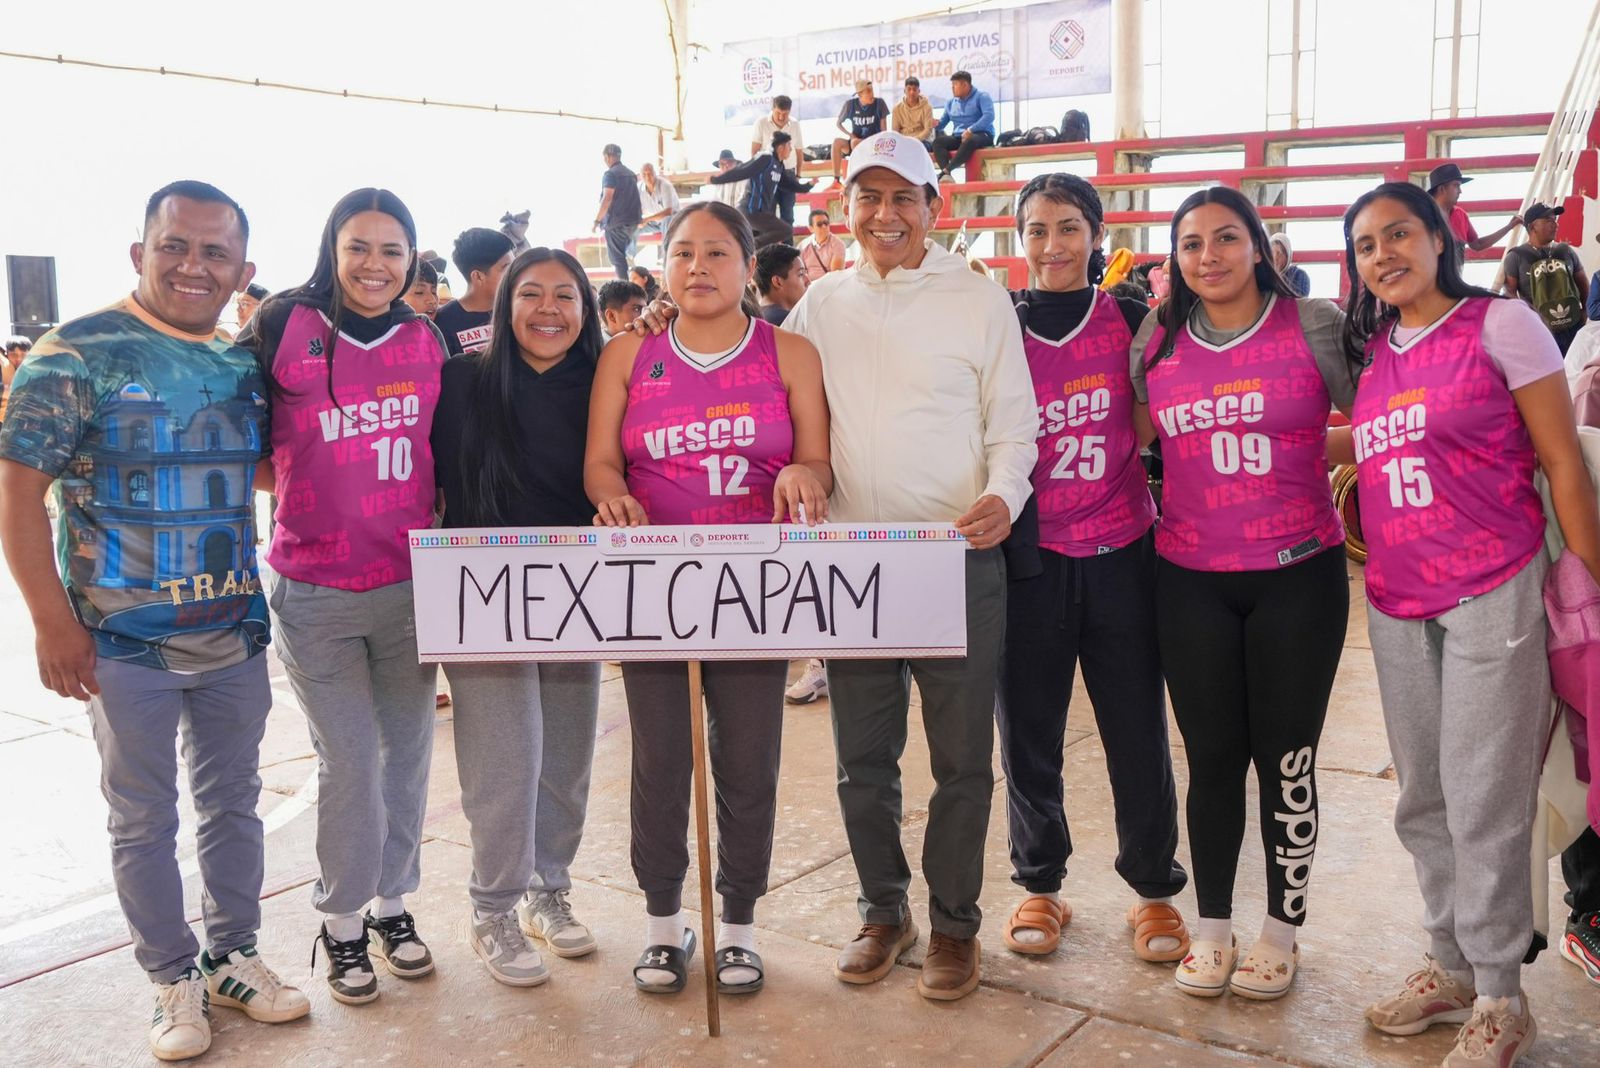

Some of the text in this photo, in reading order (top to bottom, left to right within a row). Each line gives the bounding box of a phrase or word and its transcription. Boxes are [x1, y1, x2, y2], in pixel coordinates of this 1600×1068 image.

[815, 32, 1000, 66] ACTIVIDADES DEPORTIVAS
[1049, 65, 1085, 76] DEPORTE
[799, 59, 953, 91] San Melchor Betaza
[459, 329, 481, 343] SAN
[318, 394, 420, 443] VESCO
[1036, 387, 1111, 438] ESCO
[1157, 391, 1264, 438] VESCO
[1352, 403, 1427, 465] VESCO
[371, 436, 413, 481] 10
[643, 415, 756, 460] VESCO
[1050, 435, 1106, 481] 25
[1210, 430, 1272, 476] 09
[699, 454, 750, 496] 12
[1382, 457, 1434, 508] 15
[630, 533, 750, 544] OAXACA DEPORTE
[458, 559, 881, 645] MEXICAPAM
[1274, 745, 1317, 919] adidas
